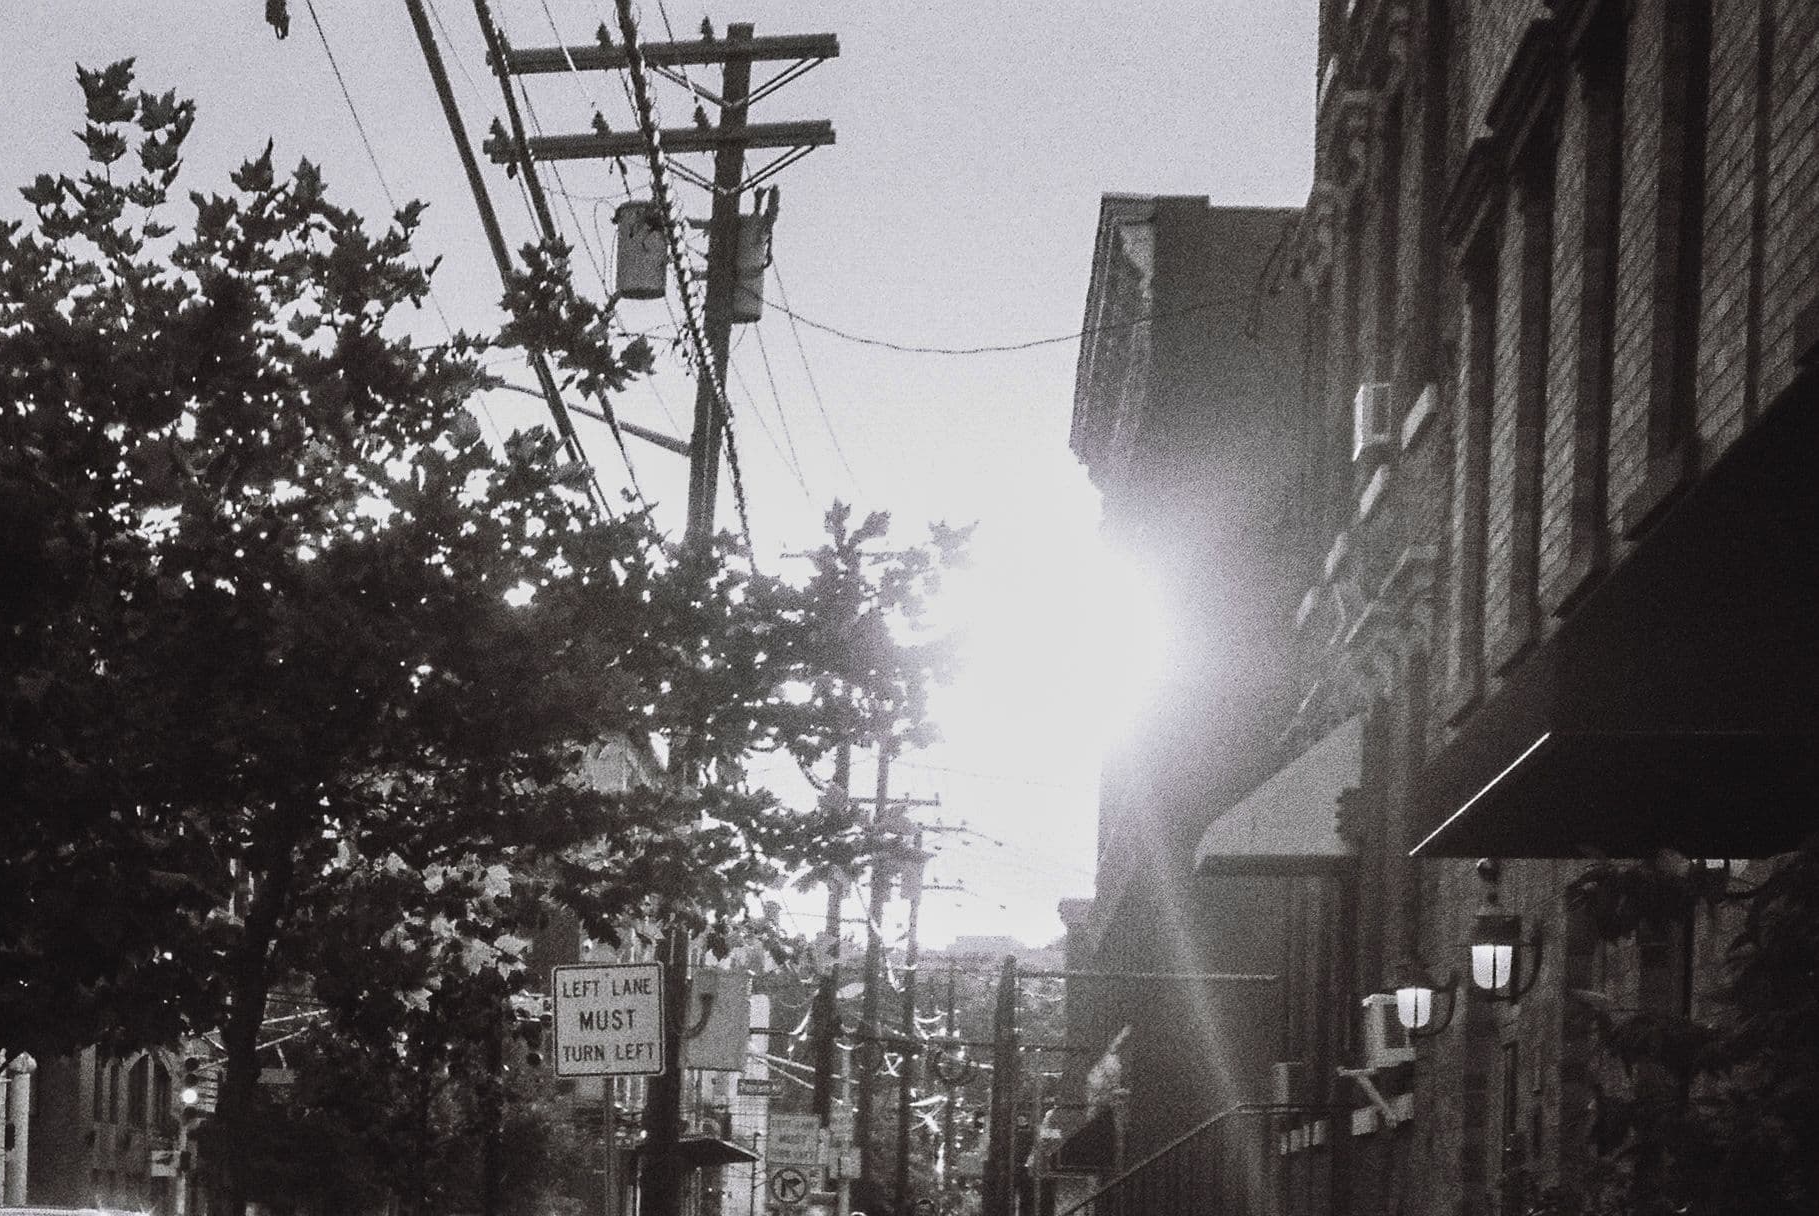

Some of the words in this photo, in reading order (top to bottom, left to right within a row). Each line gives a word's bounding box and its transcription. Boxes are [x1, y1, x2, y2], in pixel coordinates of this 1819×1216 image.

[562, 980, 600, 999] LEFT
[612, 978, 652, 997] LANE
[579, 1009, 636, 1032] MUST
[563, 1045, 605, 1063] TURN
[616, 1043, 654, 1061] LEFT
